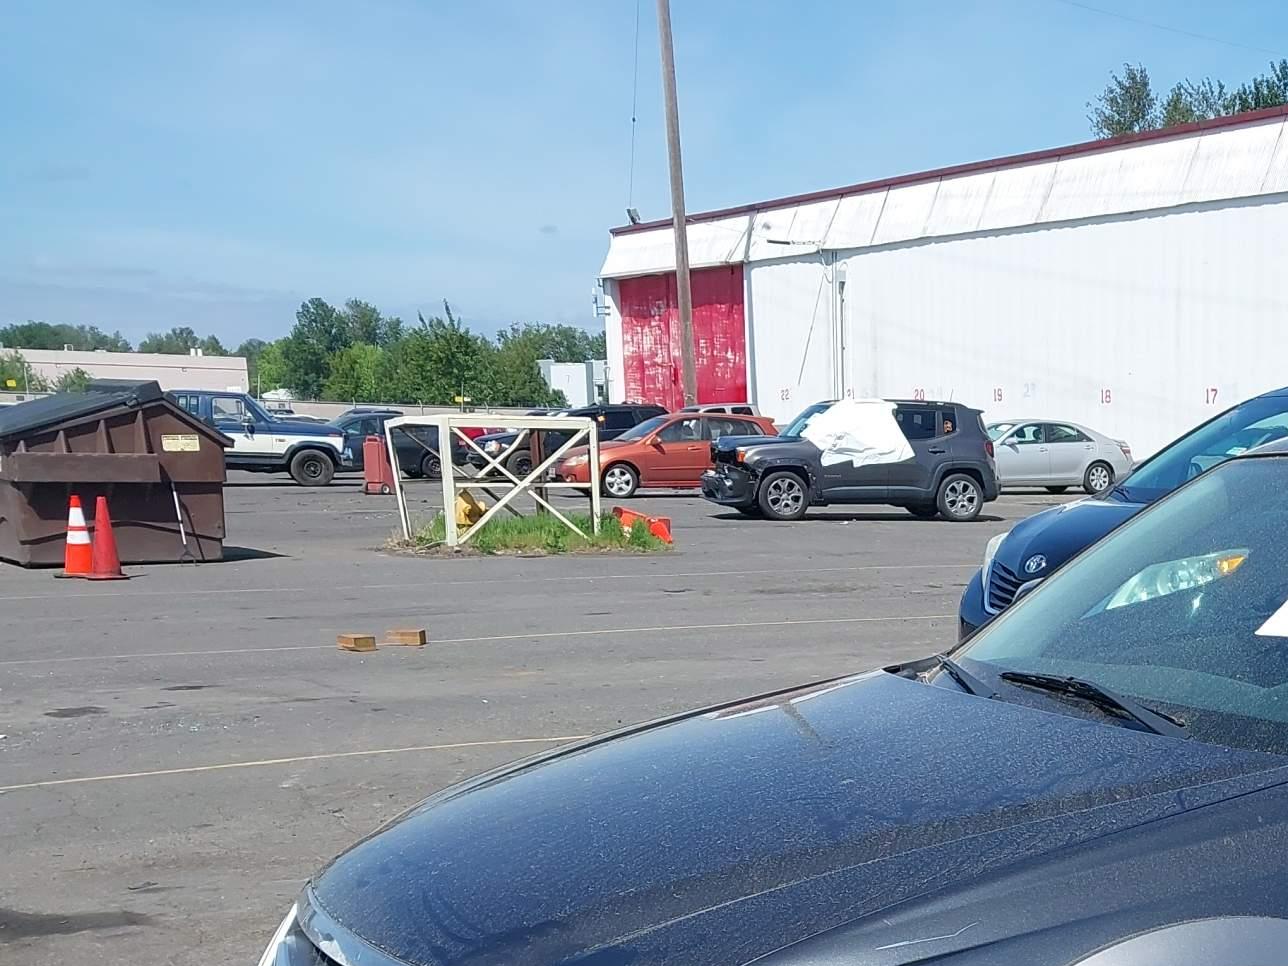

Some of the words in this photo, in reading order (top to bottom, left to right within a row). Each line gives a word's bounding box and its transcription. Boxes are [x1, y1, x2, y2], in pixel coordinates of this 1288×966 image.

[780, 389, 790, 400] 22
[914, 388, 925, 401] 20
[993, 388, 1003, 402] 19
[1100, 389, 1111, 404] 18
[1206, 388, 1218, 404] 17
